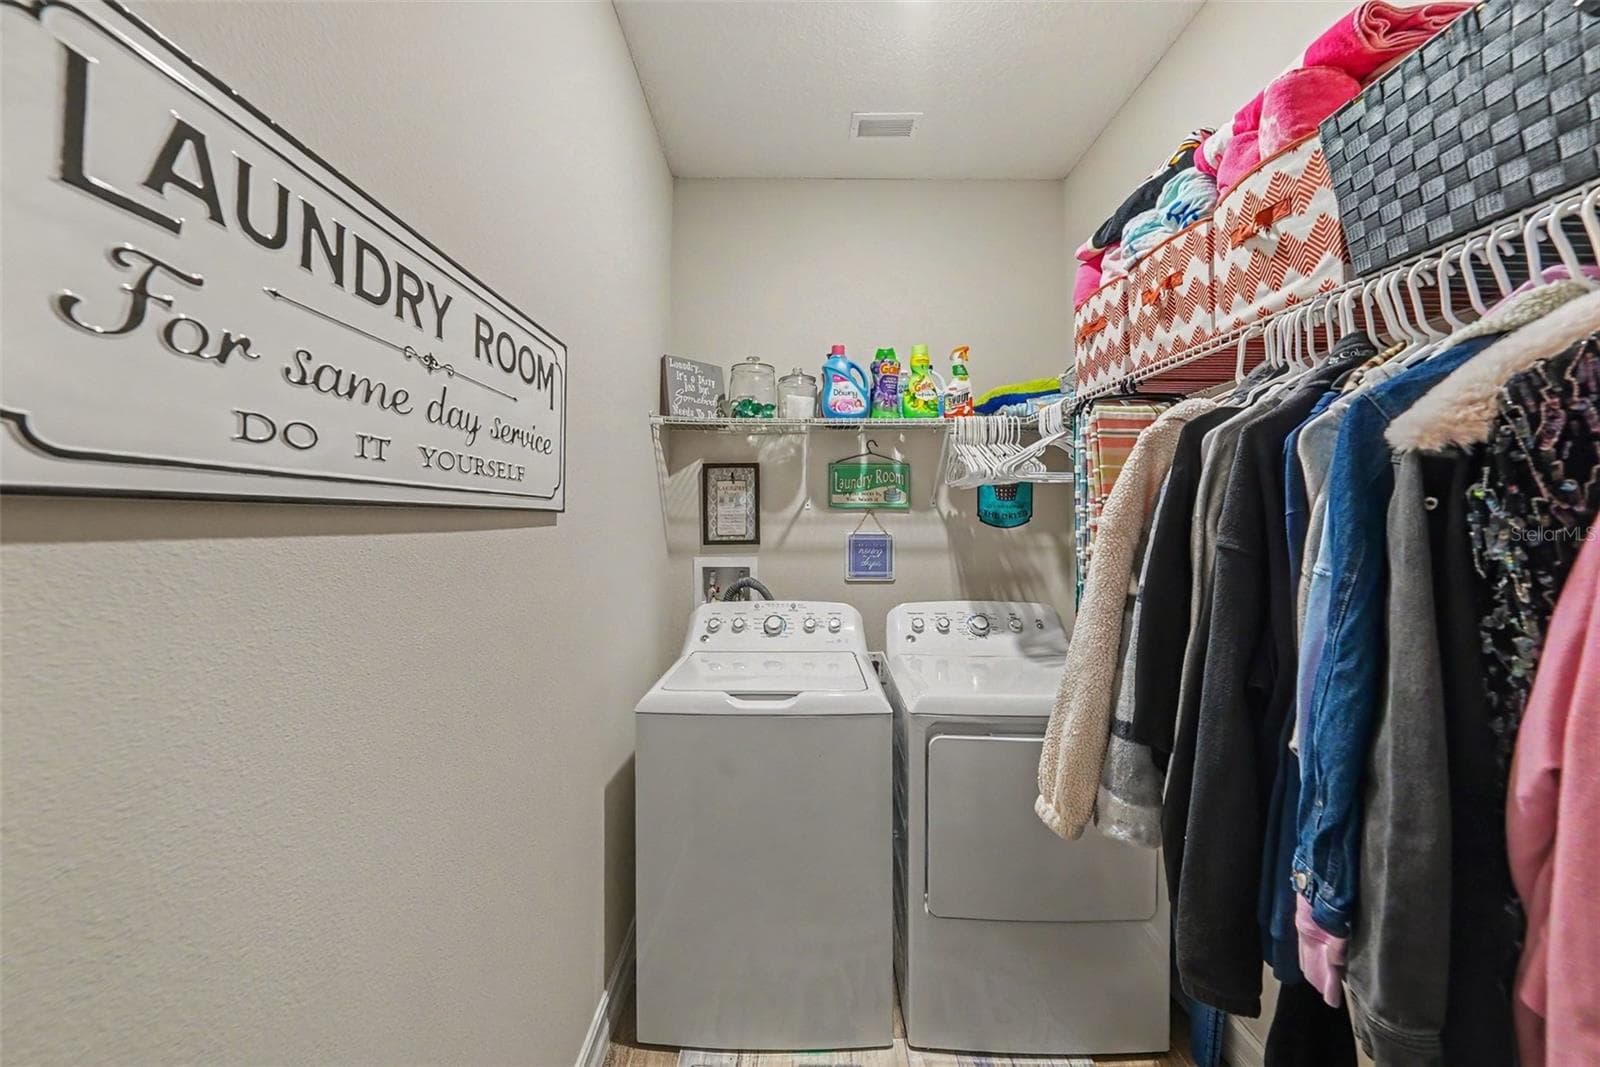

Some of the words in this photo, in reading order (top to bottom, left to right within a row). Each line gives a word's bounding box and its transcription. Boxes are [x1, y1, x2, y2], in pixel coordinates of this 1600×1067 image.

[59, 40, 453, 340] LAUNDRY
[474, 313, 555, 411] ROOM
[57, 243, 260, 364] For
[285, 348, 414, 416] same
[427, 387, 482, 445] day
[490, 417, 554, 455] service
[833, 388, 858, 399] Downy
[232, 408, 319, 450] DO
[354, 433, 391, 462] IT
[418, 445, 526, 483] YOURSELF
[834, 471, 873, 492] Laundry
[875, 469, 904, 485] Room
